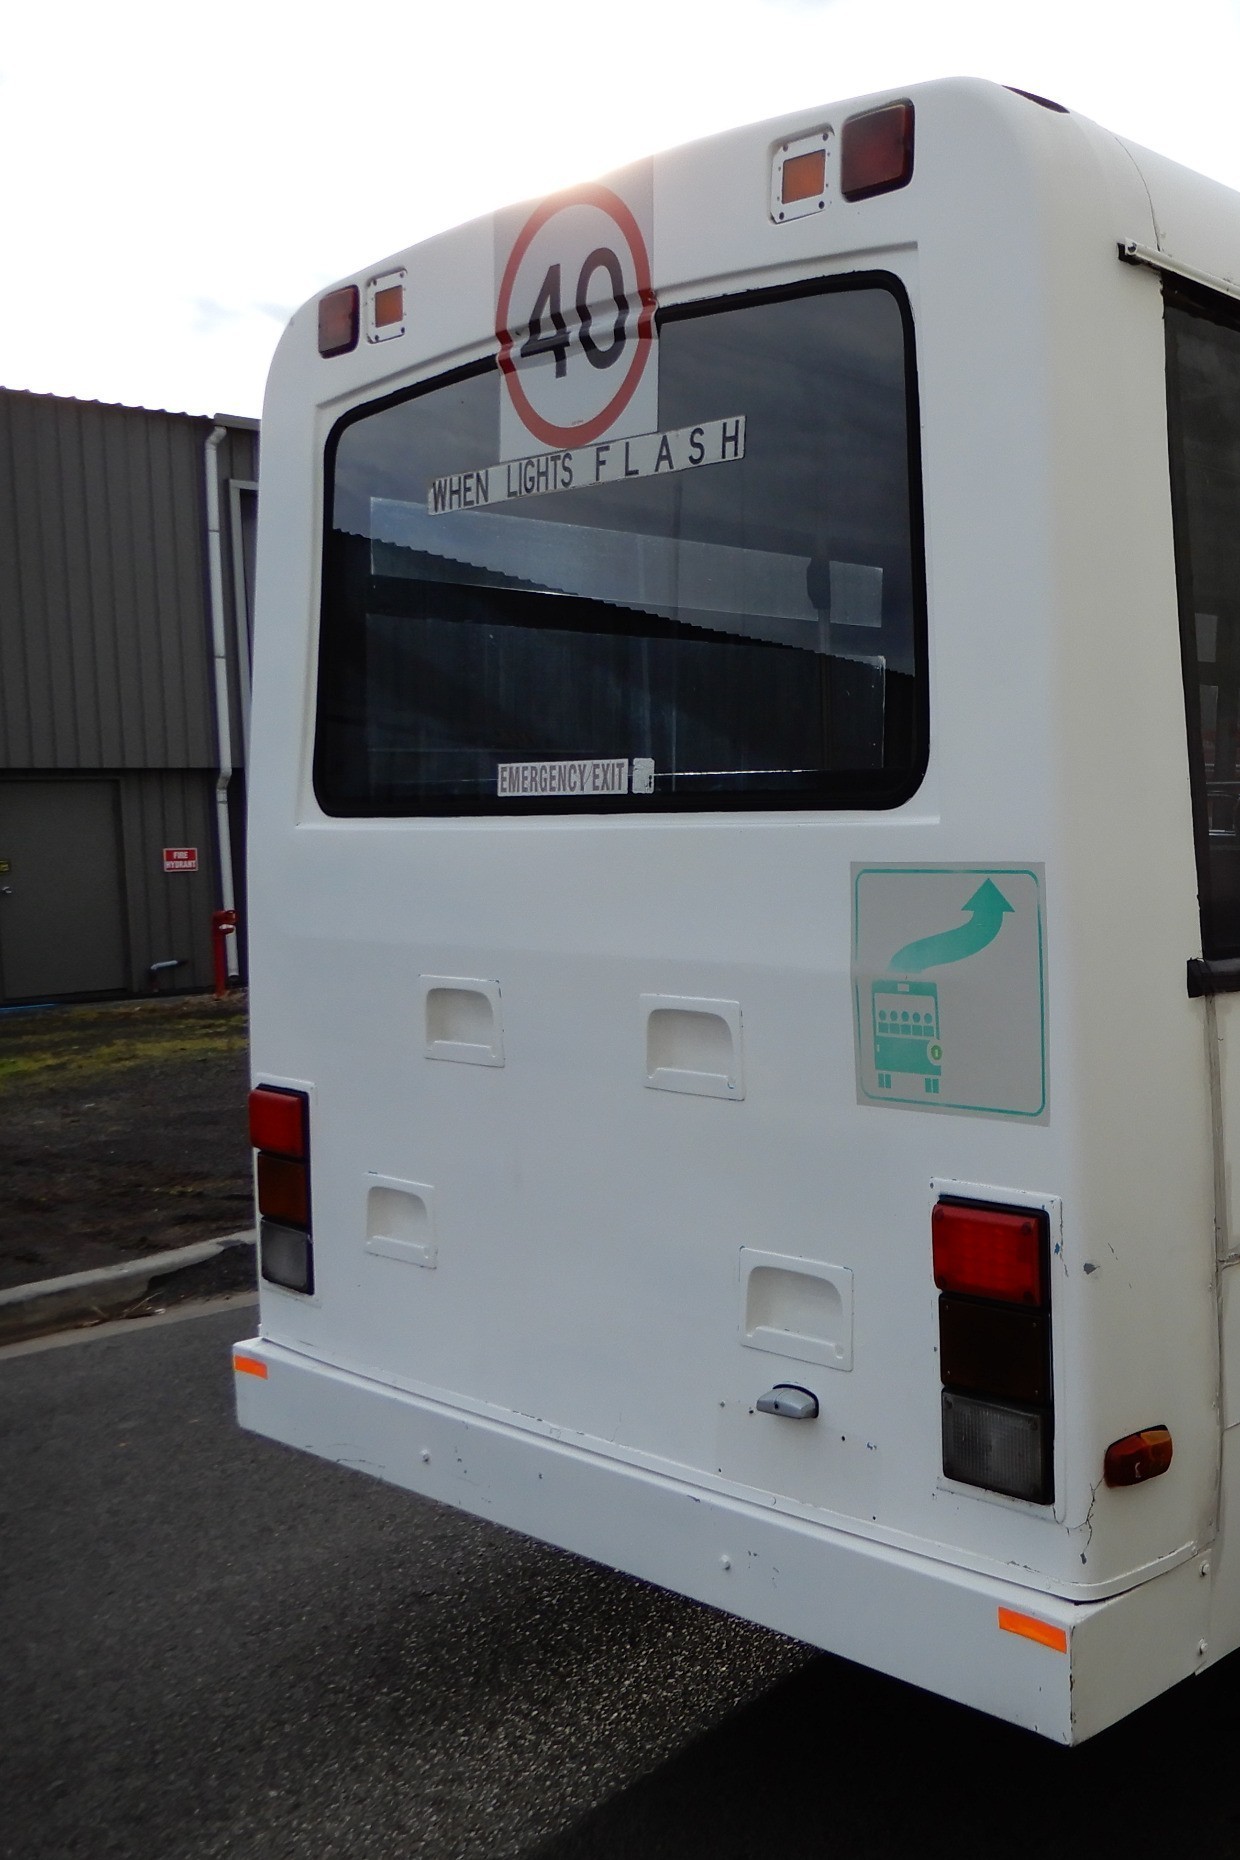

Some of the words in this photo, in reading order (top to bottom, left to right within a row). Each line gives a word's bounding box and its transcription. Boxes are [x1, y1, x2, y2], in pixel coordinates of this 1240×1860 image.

[520, 247, 630, 379] 40
[432, 469, 490, 512] WHEN
[506, 452, 574, 498] LIGHTS
[594, 419, 740, 482] FLASH
[500, 763, 587, 793] EMERGENCY
[592, 762, 625, 791] EXIT
[173, 851, 188, 859] FIRE
